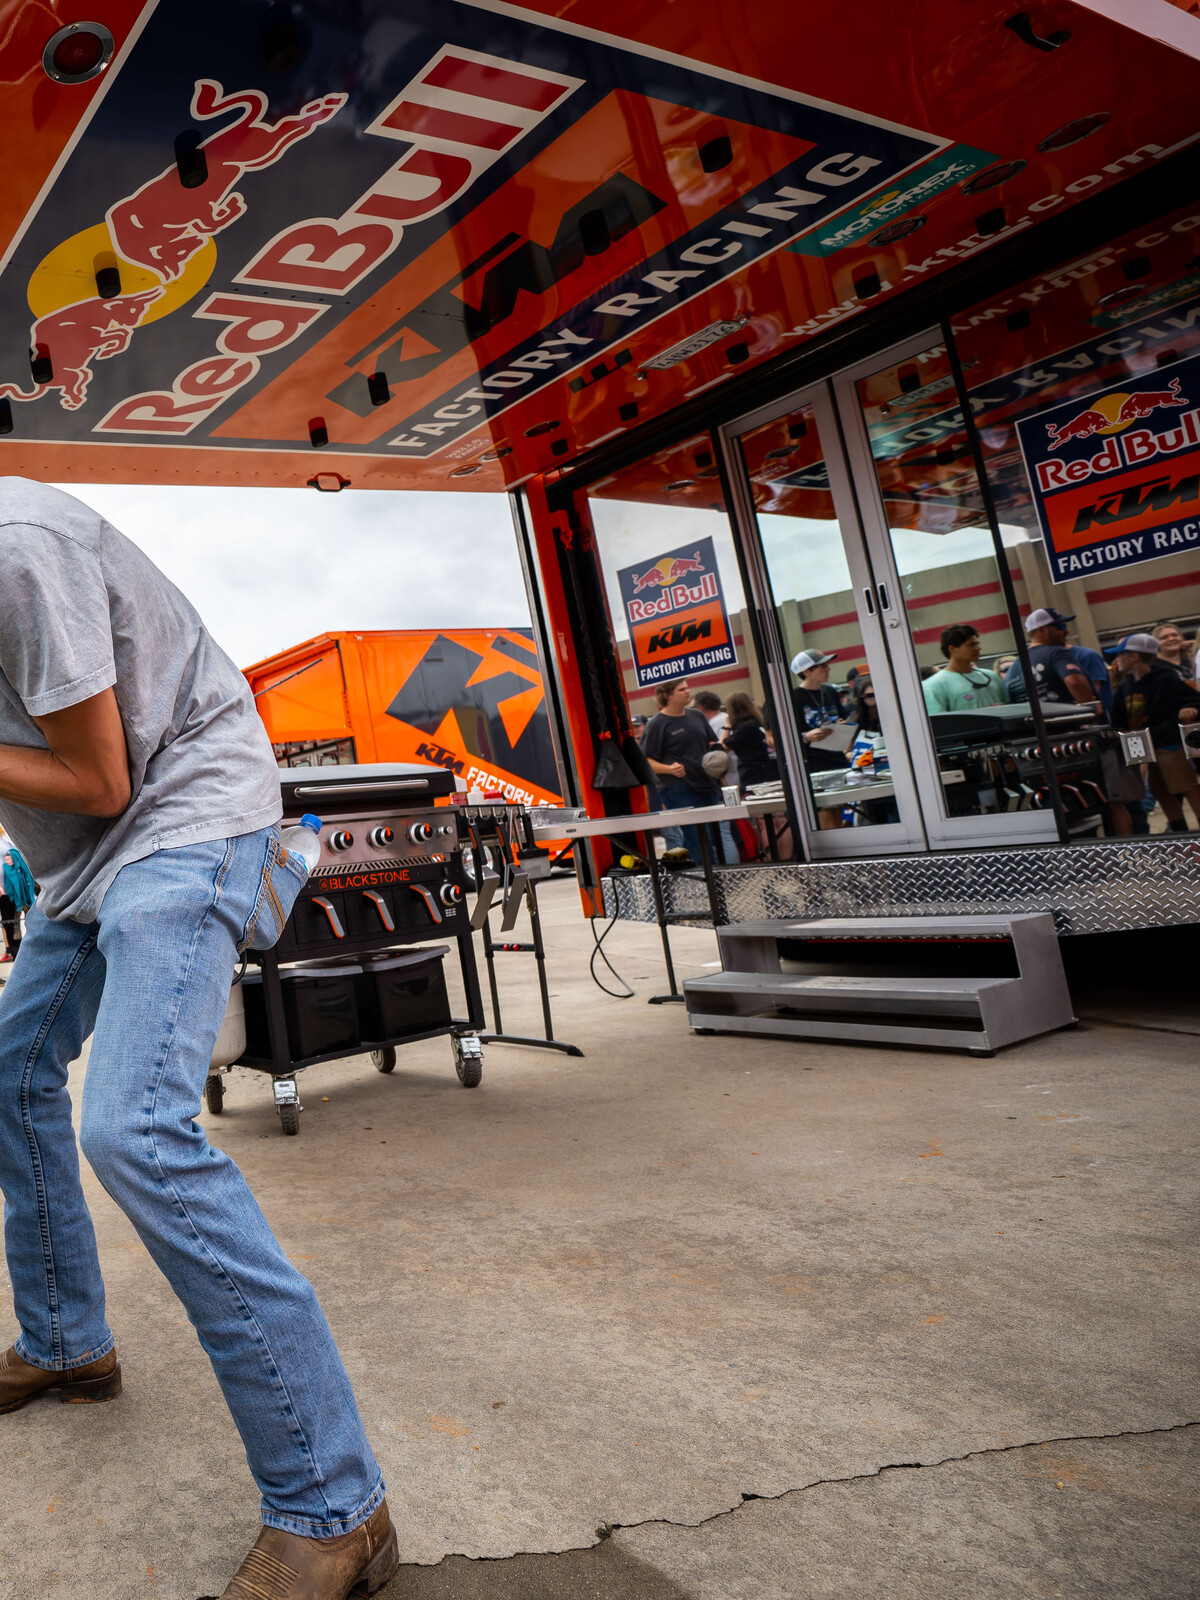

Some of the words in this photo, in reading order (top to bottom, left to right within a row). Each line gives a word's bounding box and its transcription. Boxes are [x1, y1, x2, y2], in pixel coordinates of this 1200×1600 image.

[820, 161, 966, 246] MOTOREX
[878, 164, 977, 220] Switzerland
[92, 291, 331, 435] Red
[232, 43, 586, 296] Bull
[325, 171, 668, 418] KTM
[387, 326, 594, 448] FACTORY
[593, 152, 882, 317] RACING
[1035, 436, 1123, 492] Red
[1120, 406, 1200, 466] Bul
[1072, 474, 1200, 534] KTM
[1057, 536, 1144, 574] FACTORY
[627, 587, 672, 622] Red
[671, 572, 718, 609] Bull
[640, 659, 684, 682] FACTORY
[688, 647, 732, 669] RACING
[648, 618, 711, 653] KTM
[415, 742, 465, 775] KTM
[467, 766, 534, 807] FACTORY
[329, 869, 411, 890] BLACKSTONE
